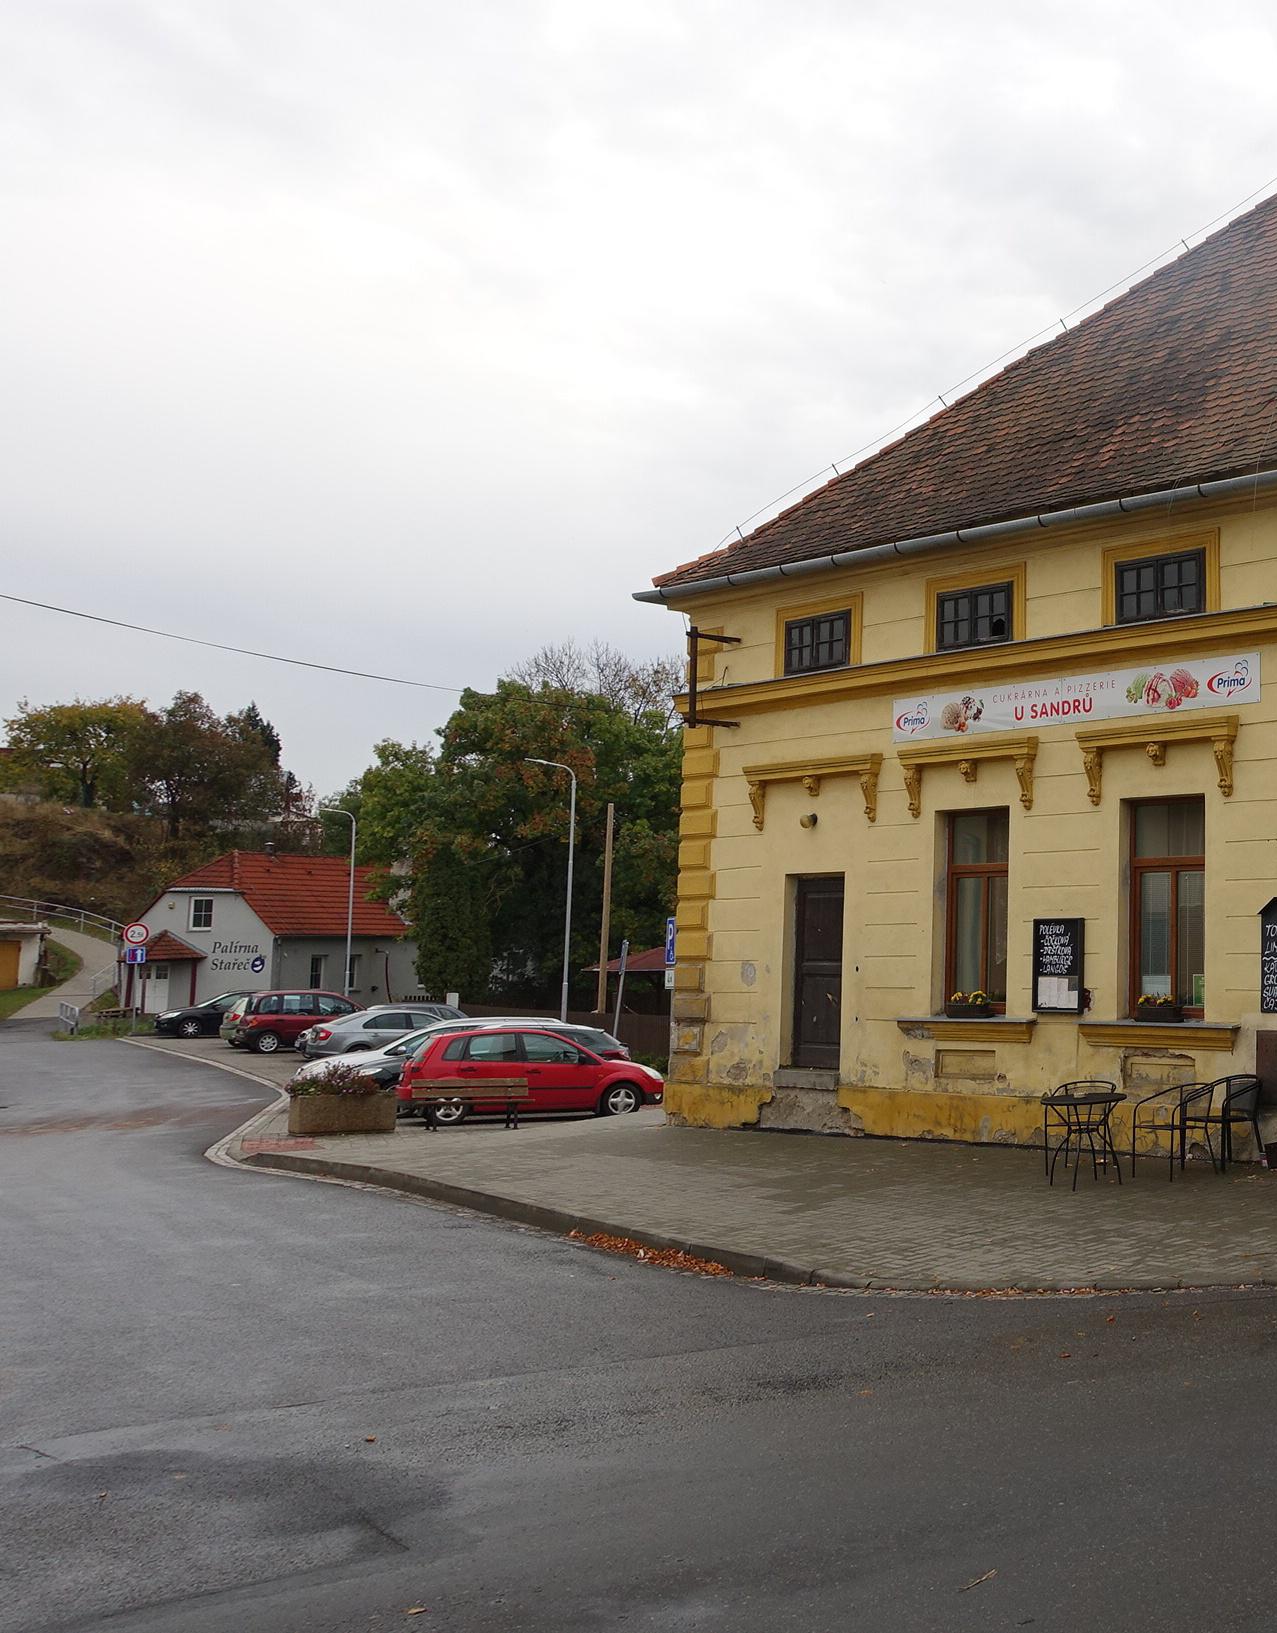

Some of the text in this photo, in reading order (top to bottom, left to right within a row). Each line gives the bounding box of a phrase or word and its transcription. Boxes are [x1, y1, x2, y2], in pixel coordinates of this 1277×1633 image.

[1217, 676, 1246, 689] Prima
[992, 680, 1116, 704] CUKRÁRNA A PIZZERIE
[1014, 692, 1093, 721] U SANDRŮ
[903, 715, 925, 727] Prima
[211, 941, 259, 954] Palírna
[210, 958, 251, 971] Stařeč
